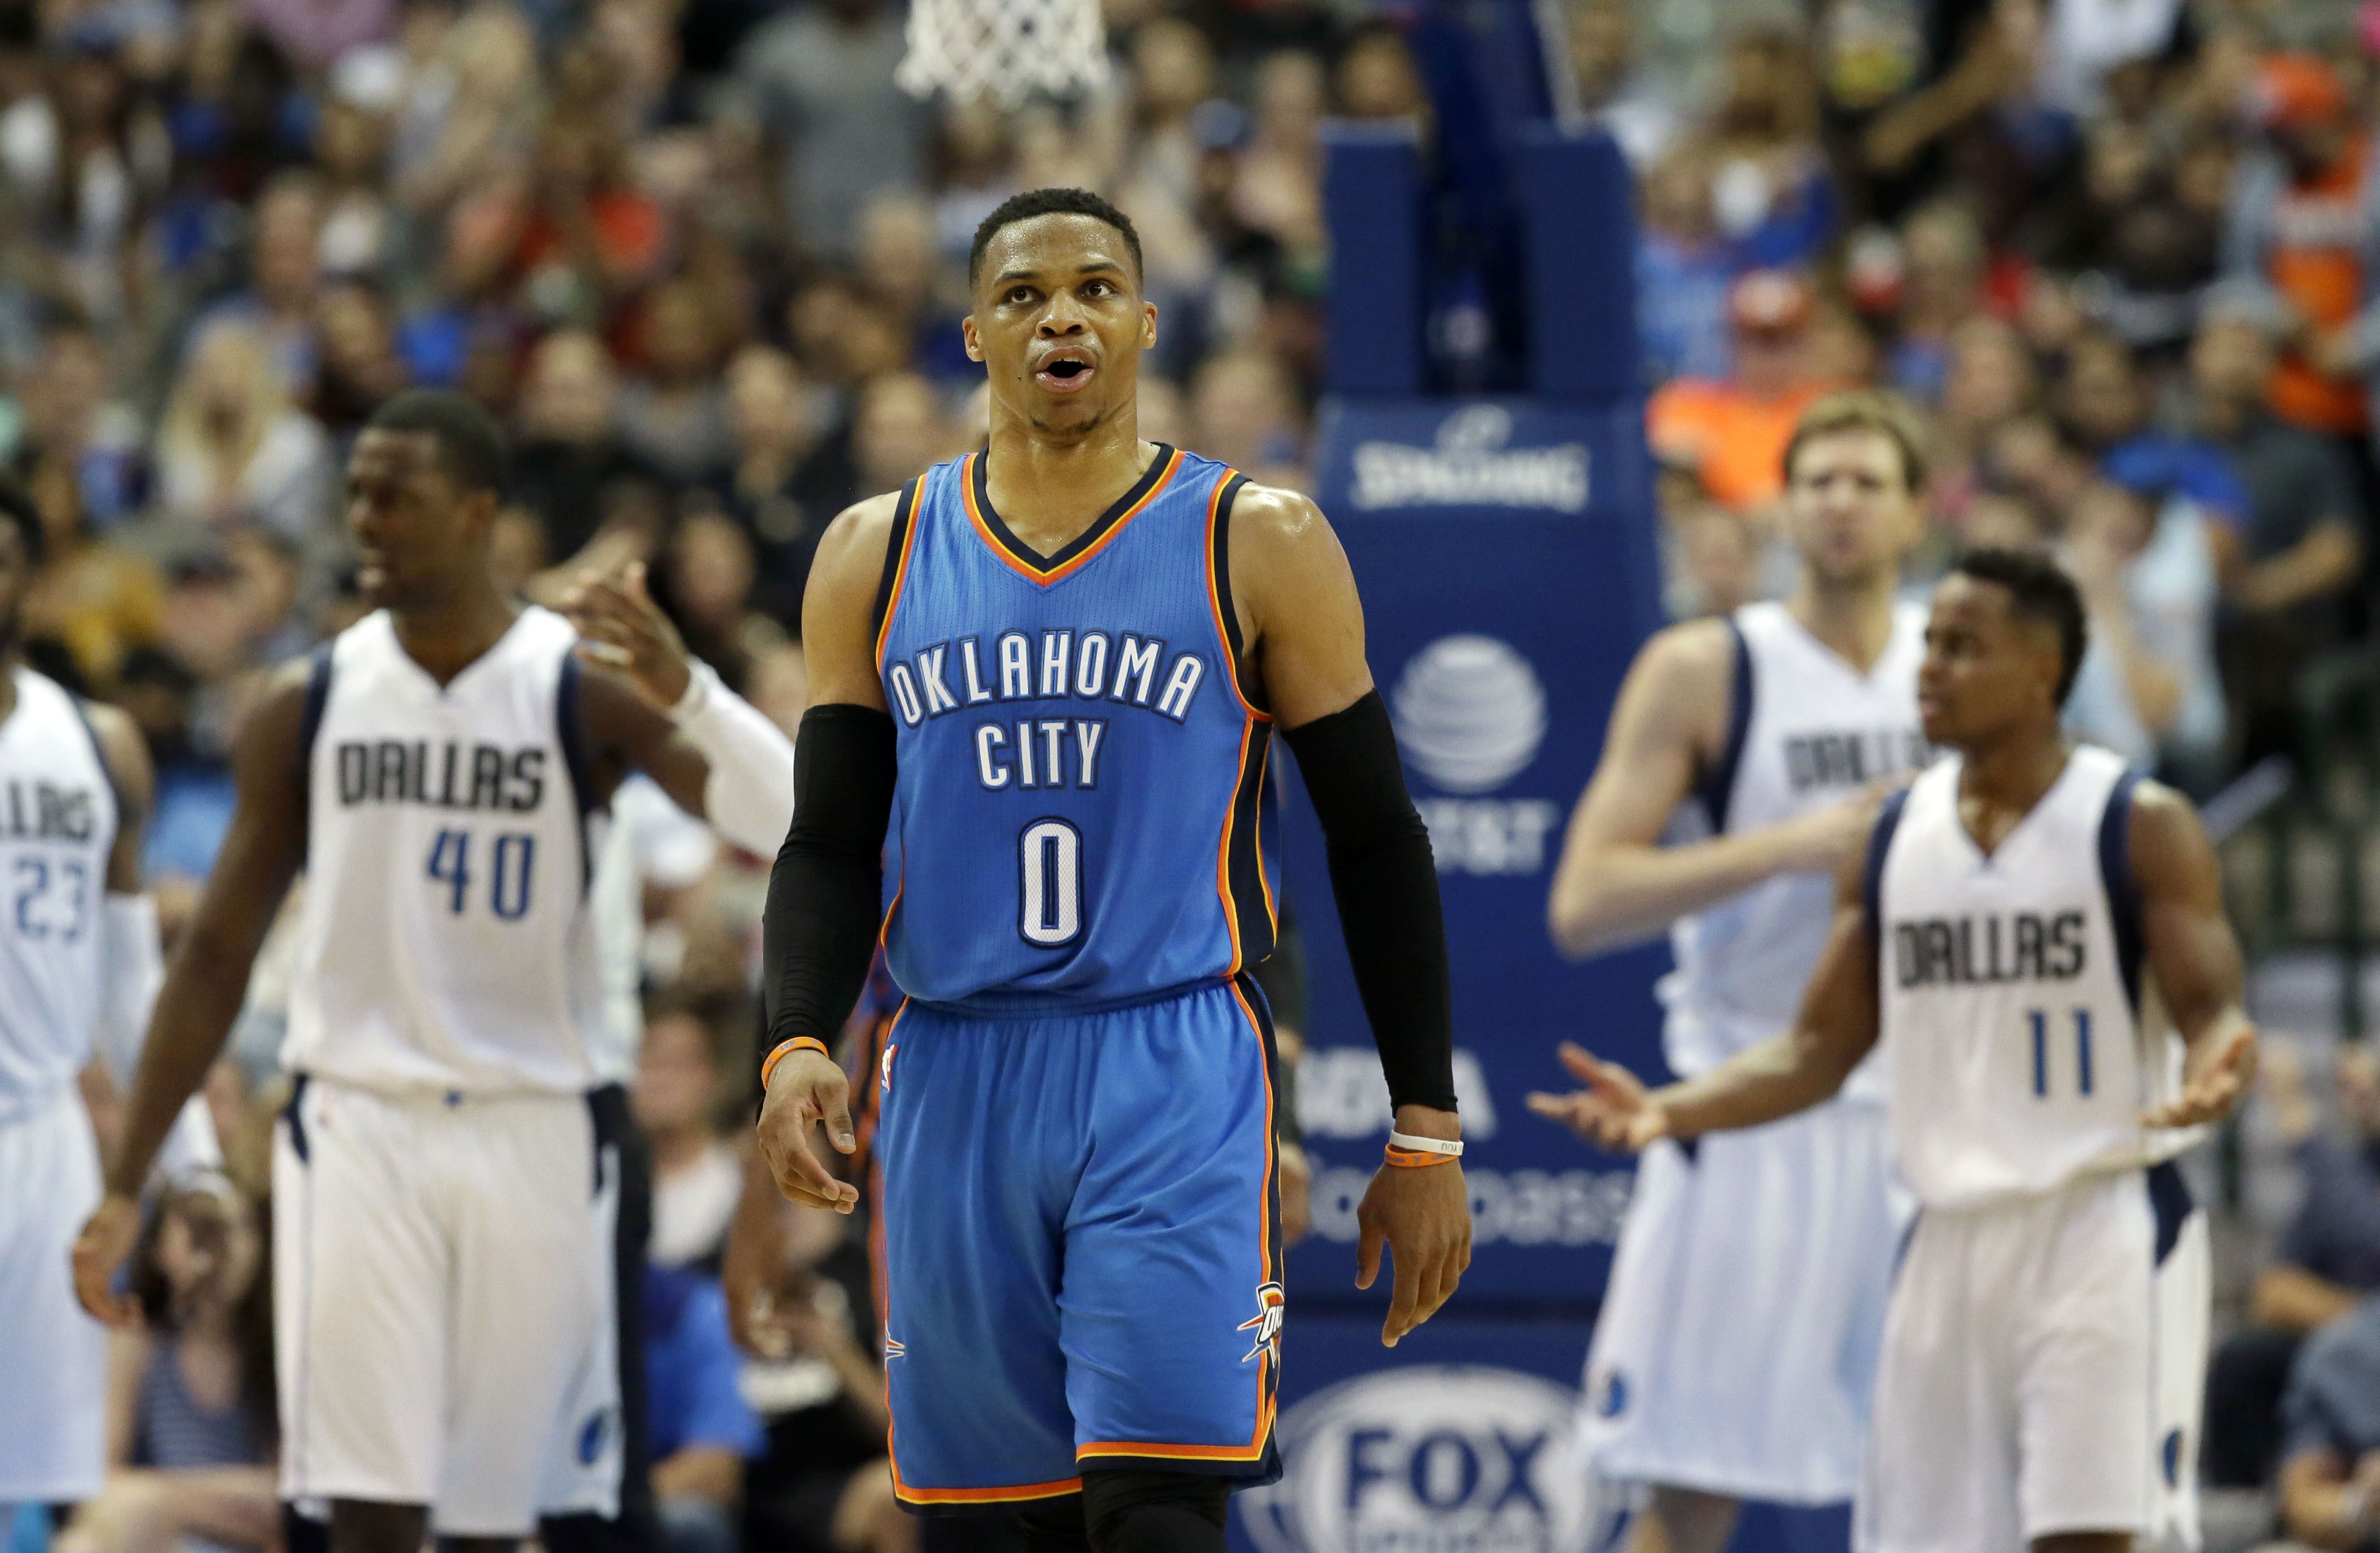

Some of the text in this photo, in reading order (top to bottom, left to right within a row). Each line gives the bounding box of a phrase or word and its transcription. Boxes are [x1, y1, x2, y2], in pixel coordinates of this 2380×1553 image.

[889, 630, 1204, 727] OKLAHOMA
[338, 740, 545, 813] DALLAS
[976, 718, 1108, 791] CITY
[18, 858, 87, 943] 23
[428, 829, 535, 922] 40
[1018, 816, 1085, 948] 0
[1895, 911, 2085, 987] DALLAS
[2026, 1006, 2092, 1099] 11
[1259, 1304, 1285, 1343] OK
[1346, 1426, 1546, 1517] FOX
